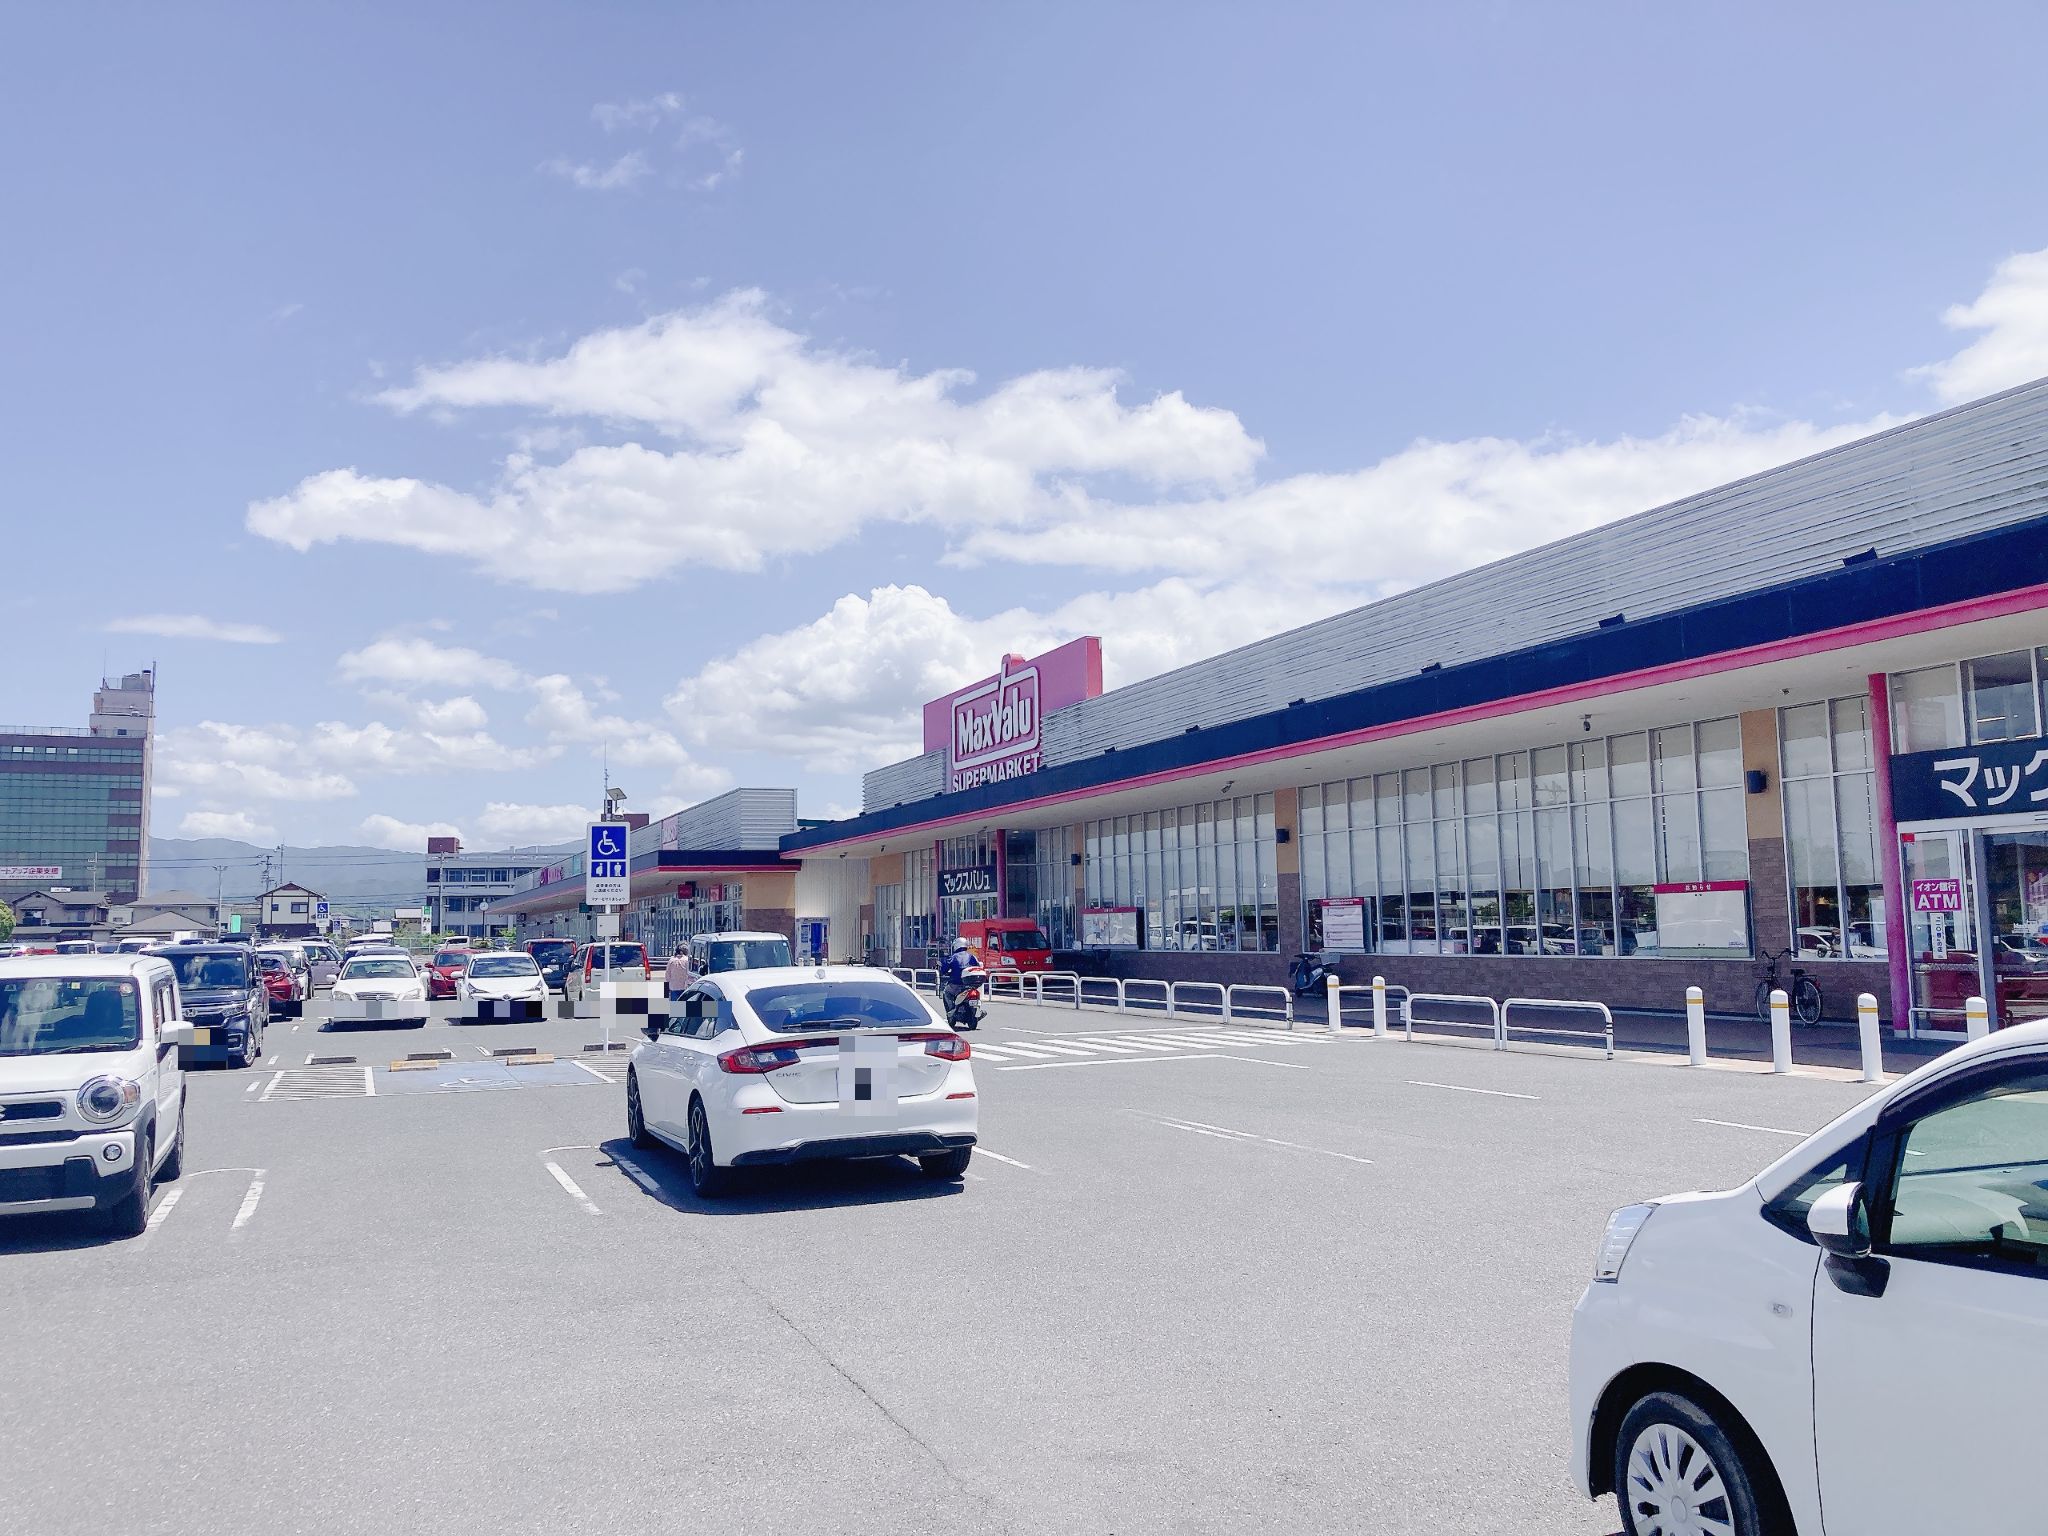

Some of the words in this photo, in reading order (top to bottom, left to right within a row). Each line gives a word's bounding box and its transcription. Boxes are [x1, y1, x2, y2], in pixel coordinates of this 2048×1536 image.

[958, 664, 1032, 756] MaxValu
[952, 752, 1040, 792] SUPERMARKET
[944, 869, 990, 893] マックスバリュ
[1916, 881, 1957, 892] イオン銀行
[1917, 893, 1958, 909] ATM
